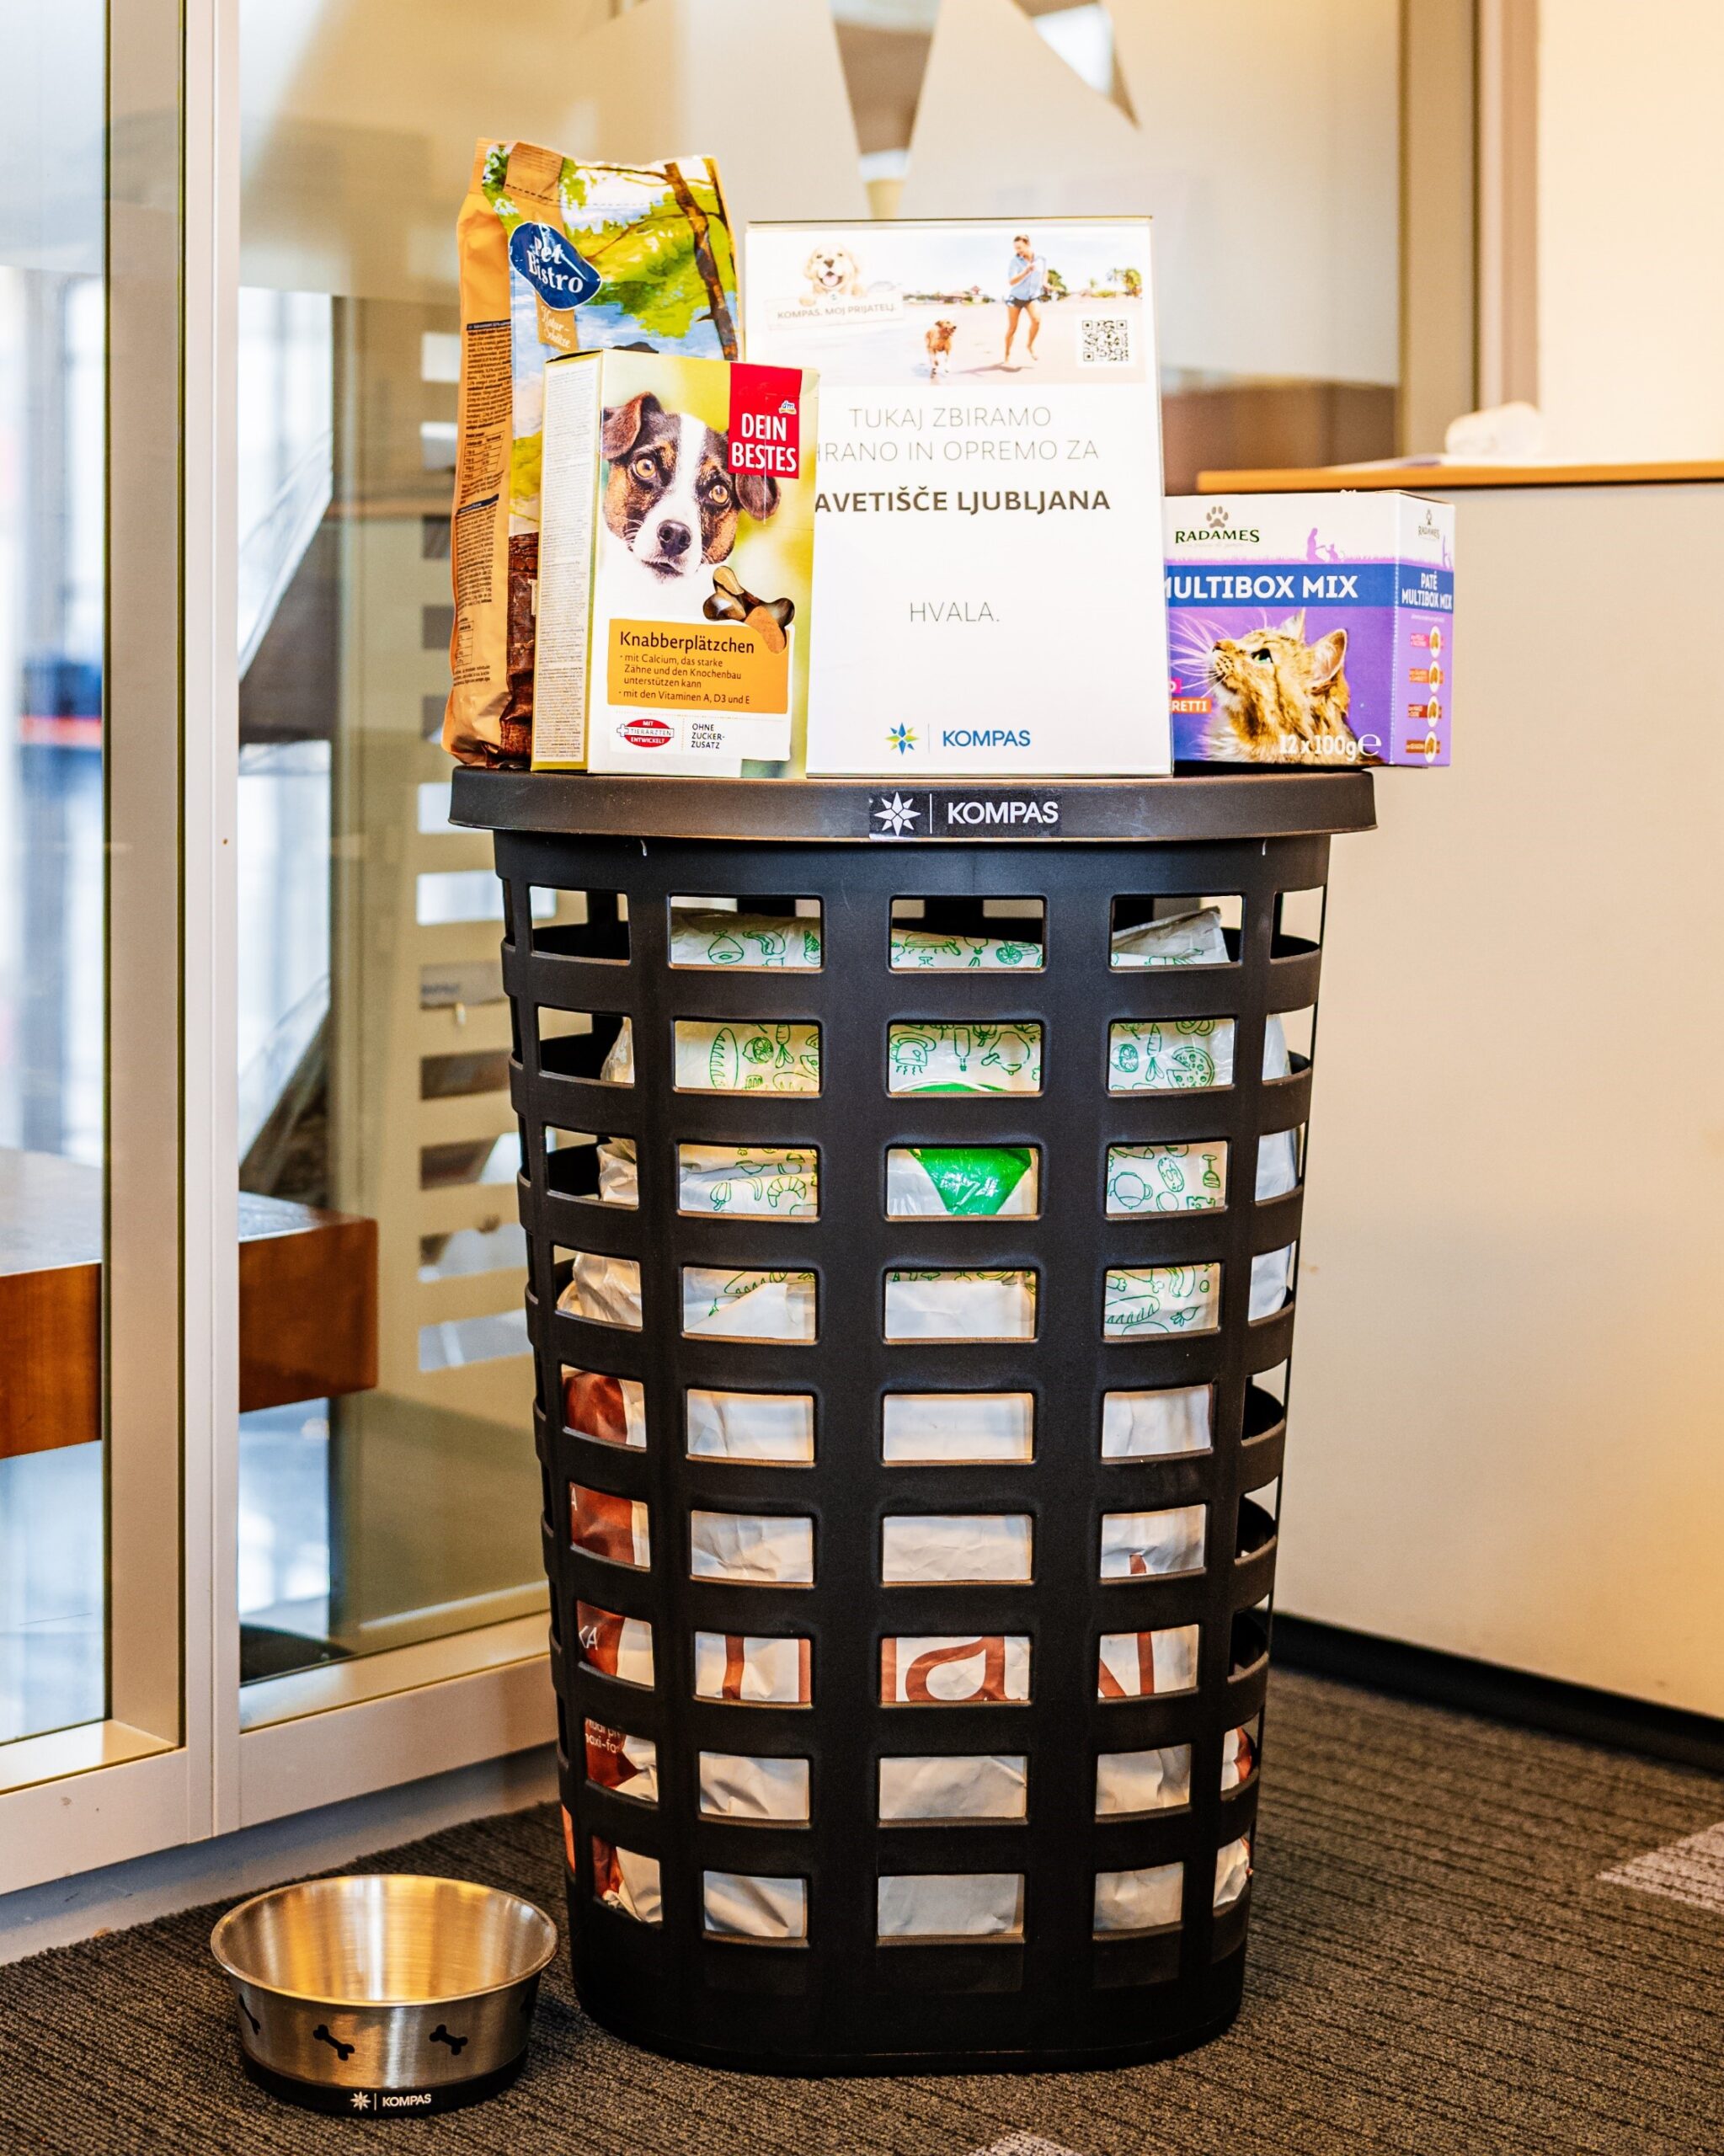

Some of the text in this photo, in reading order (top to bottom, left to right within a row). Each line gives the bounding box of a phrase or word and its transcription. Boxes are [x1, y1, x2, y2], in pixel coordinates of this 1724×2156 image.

[534, 236, 563, 264] Pet
[527, 250, 584, 293] Bistro
[825, 307, 846, 316] MOJ
[741, 413, 787, 441] DEIN
[849, 406, 1051, 430] TUKAJ ZBIRAMO
[731, 442, 797, 472] BESTES
[908, 441, 933, 462] IN
[943, 440, 1058, 462] OPREMO
[1066, 440, 1099, 460] ZA
[814, 486, 1111, 516] AVETIŠČE LJUBLJANA
[1175, 529, 1260, 544] RADAMES
[1302, 575, 1359, 599] MIX
[1401, 588, 1439, 608] MULTIBOX
[910, 601, 1000, 622] HVALA.
[620, 631, 755, 654] Knabberplätzchen
[624, 654, 723, 667] mit Calcium, das starke
[624, 664, 742, 680] Zähne und den Knochenbau
[624, 677, 702, 688] unterstützen kann
[623, 690, 750, 704] mit den Vitaminen A, D3 und E
[691, 723, 714, 732] OHNE
[691, 732, 725, 741] ZUCKER-
[691, 740, 720, 750] ZUSATZ
[942, 729, 1031, 747] KOMPAS
[947, 801, 1059, 825] KOMPAS
[382, 2093, 432, 2107] KOMPAS
